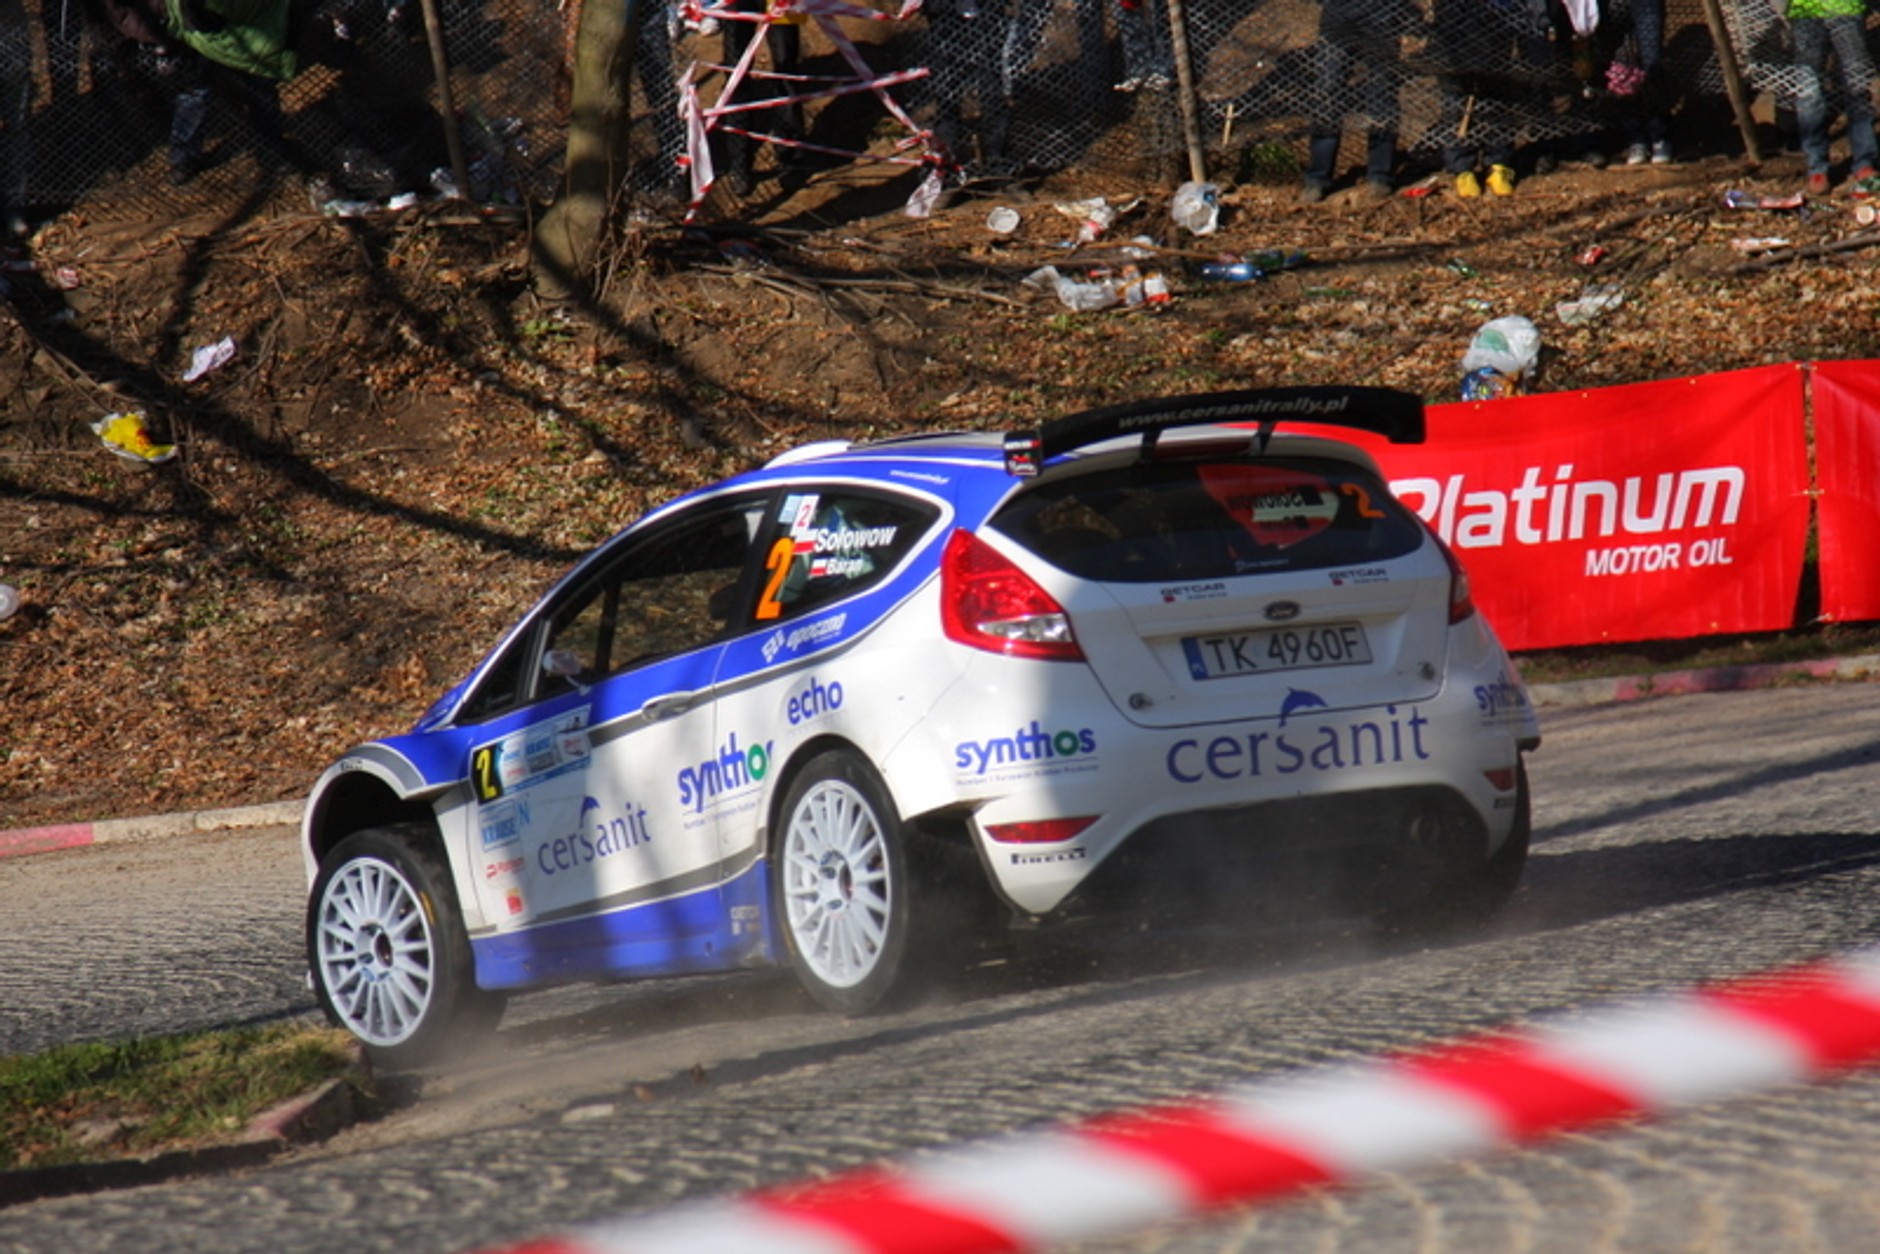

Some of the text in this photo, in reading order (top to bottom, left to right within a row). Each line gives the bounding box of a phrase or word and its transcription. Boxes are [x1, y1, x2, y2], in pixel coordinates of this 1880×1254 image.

[1119, 396, 1348, 429] www.cersanitrally.pl
[796, 504, 812, 527] 2
[1340, 482, 1387, 519] 2
[1389, 464, 1745, 549] Platinum
[755, 537, 795, 620] 2
[1585, 537, 1733, 576] MOTOR OIL
[1206, 627, 1359, 672] TK 4960F
[787, 676, 843, 726] echo
[955, 720, 1096, 775] synthos
[1166, 704, 1430, 784] cersanit
[475, 748, 497, 800] 2
[538, 802, 652, 876] cersanit
